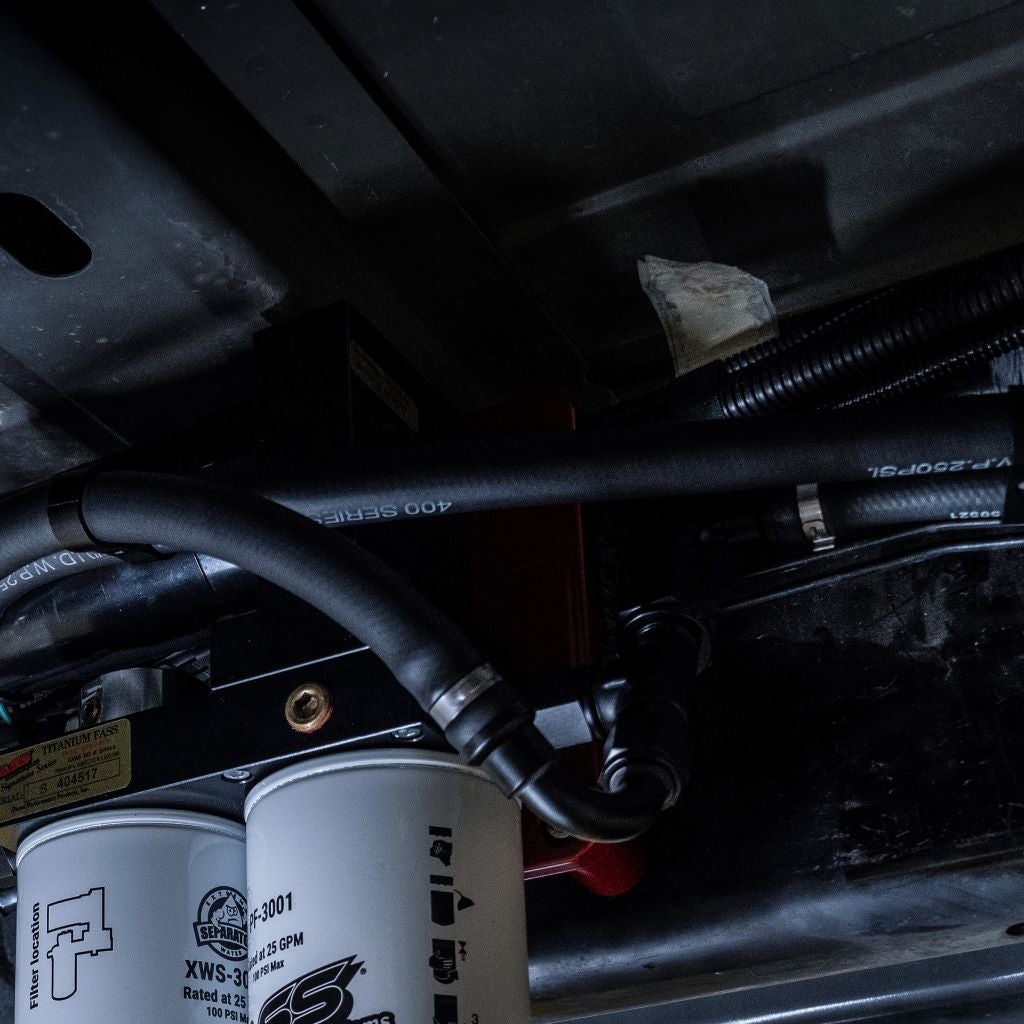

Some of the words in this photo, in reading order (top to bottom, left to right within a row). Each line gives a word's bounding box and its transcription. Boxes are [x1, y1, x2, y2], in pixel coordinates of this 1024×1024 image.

[405, 500, 452, 516] 400
[41, 732, 91, 756] TITANIUM
[94, 724, 119, 743] FASS
[56, 767, 98, 789] 404517
[249, 891, 293, 935] PF-3001
[29, 902, 40, 966] location
[220, 945, 243, 957] WATER
[258, 946, 266, 962] at
[266, 940, 277, 957] 25
[279, 931, 304, 952] GPM
[260, 963, 270, 977] PSI
[271, 959, 285, 973] Max
[29, 968, 40, 1011] Filter
[183, 985, 219, 1003] Rated
[221, 993, 232, 1006] at
[234, 993, 247, 1009] 25
[207, 1006, 223, 1018] 100
[224, 1008, 238, 1022] PSI
